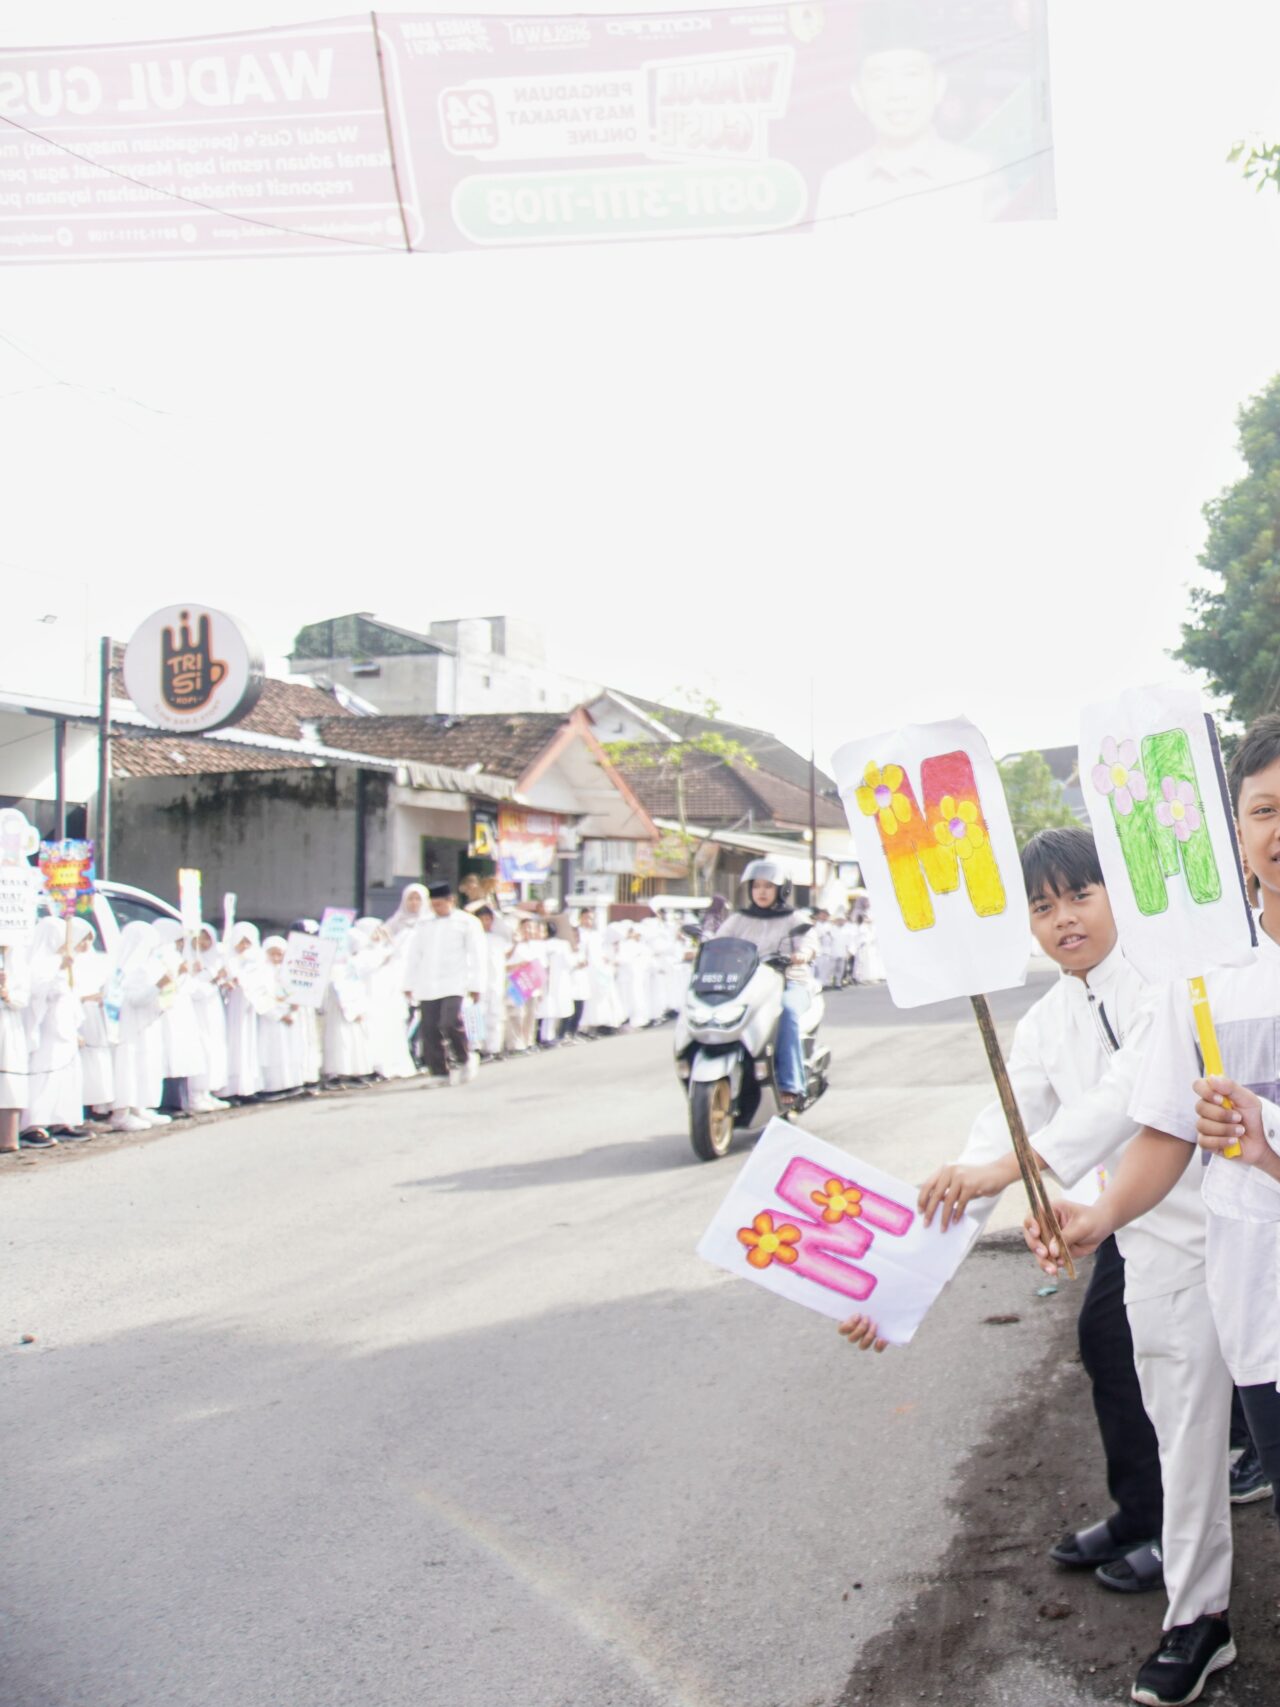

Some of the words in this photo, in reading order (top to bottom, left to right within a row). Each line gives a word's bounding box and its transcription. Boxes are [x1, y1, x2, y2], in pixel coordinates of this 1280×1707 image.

[167, 653, 203, 673] TRI
[870, 750, 1007, 931] M
[748, 1154, 916, 1301] M
